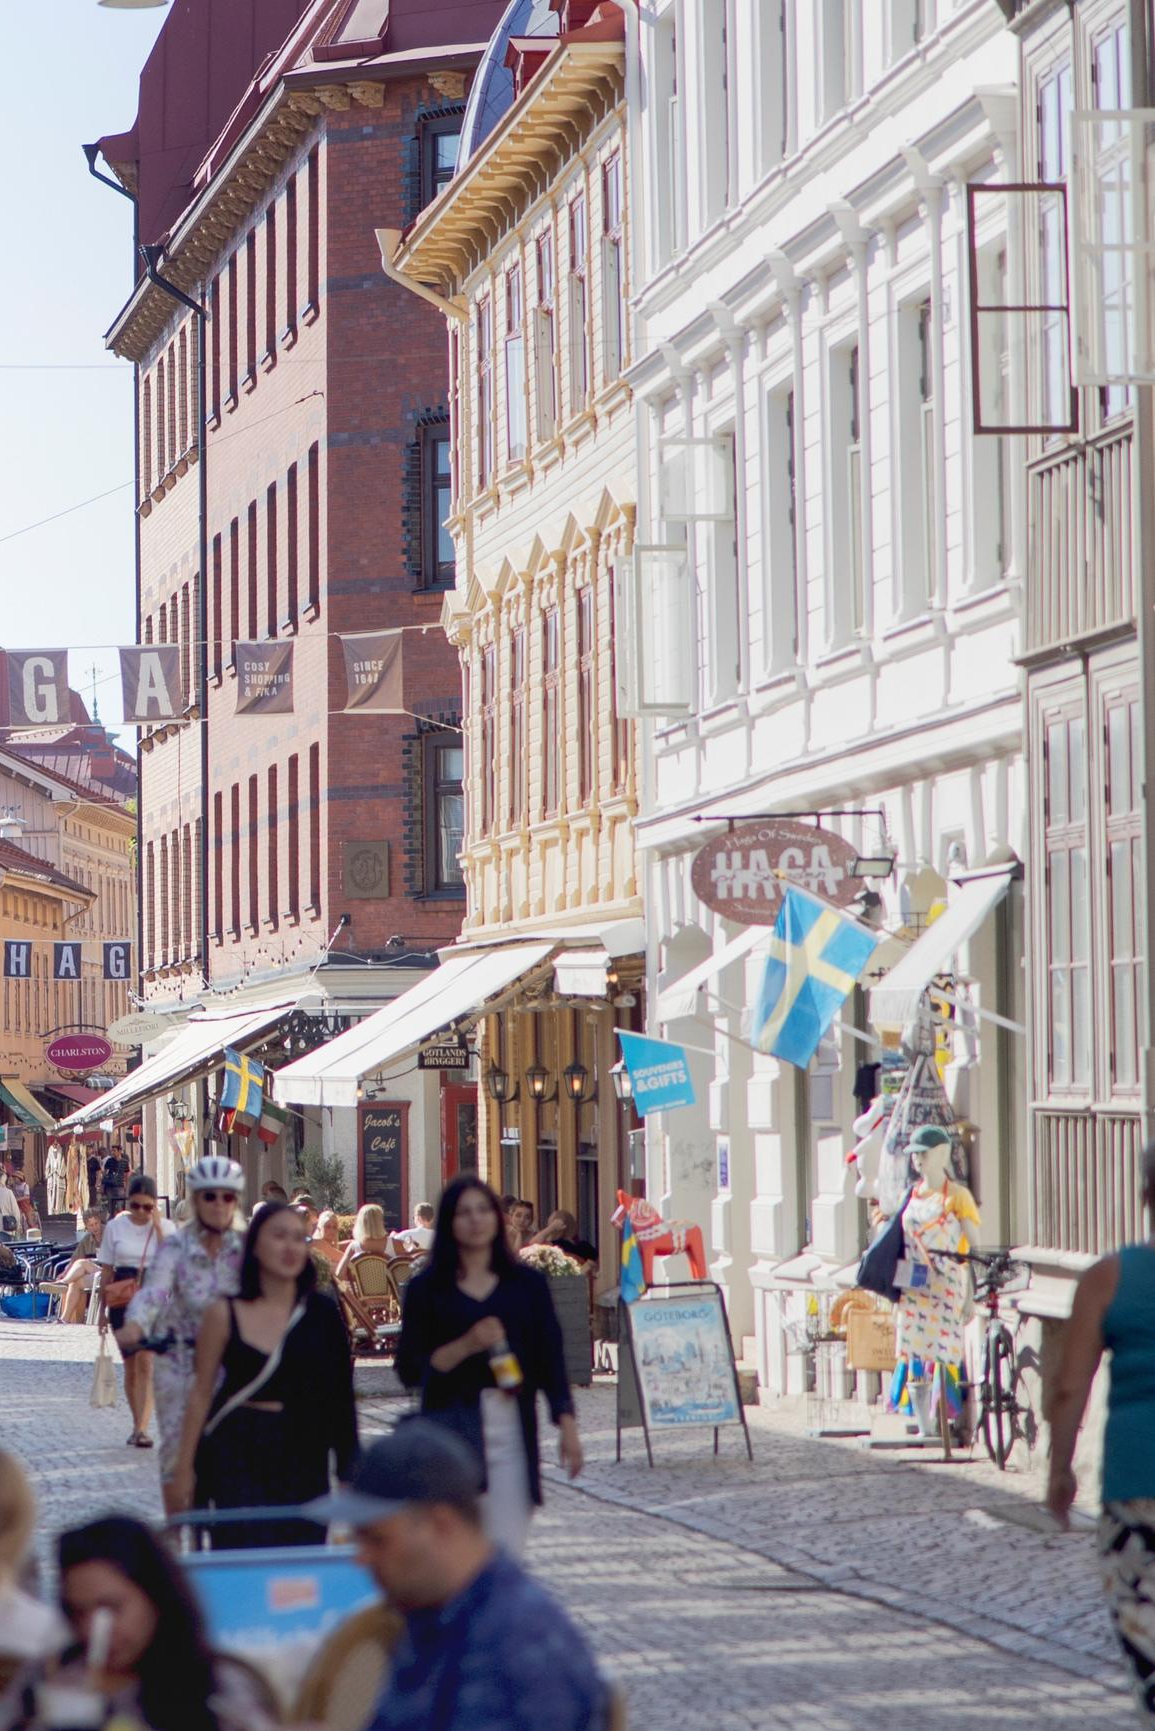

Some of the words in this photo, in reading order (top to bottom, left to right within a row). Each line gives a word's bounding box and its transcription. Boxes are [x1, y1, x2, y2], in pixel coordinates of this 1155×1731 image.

[244, 661, 270, 672] COSY
[136, 651, 175, 718] A
[244, 672, 290, 685] SHOPPING
[22, 656, 59, 724] G
[711, 844, 844, 900] HAGA
[9, 944, 27, 976] H
[58, 945, 77, 977] A
[108, 945, 126, 978] G
[50, 1047, 106, 1058] CHARLSTON
[422, 1048, 466, 1057] GOTLANDS
[424, 1057, 466, 1066] BRYGGERI
[632, 1059, 684, 1080] SOUVENIRS
[363, 1113, 401, 1131] Jacob's
[370, 1136, 397, 1153] Café
